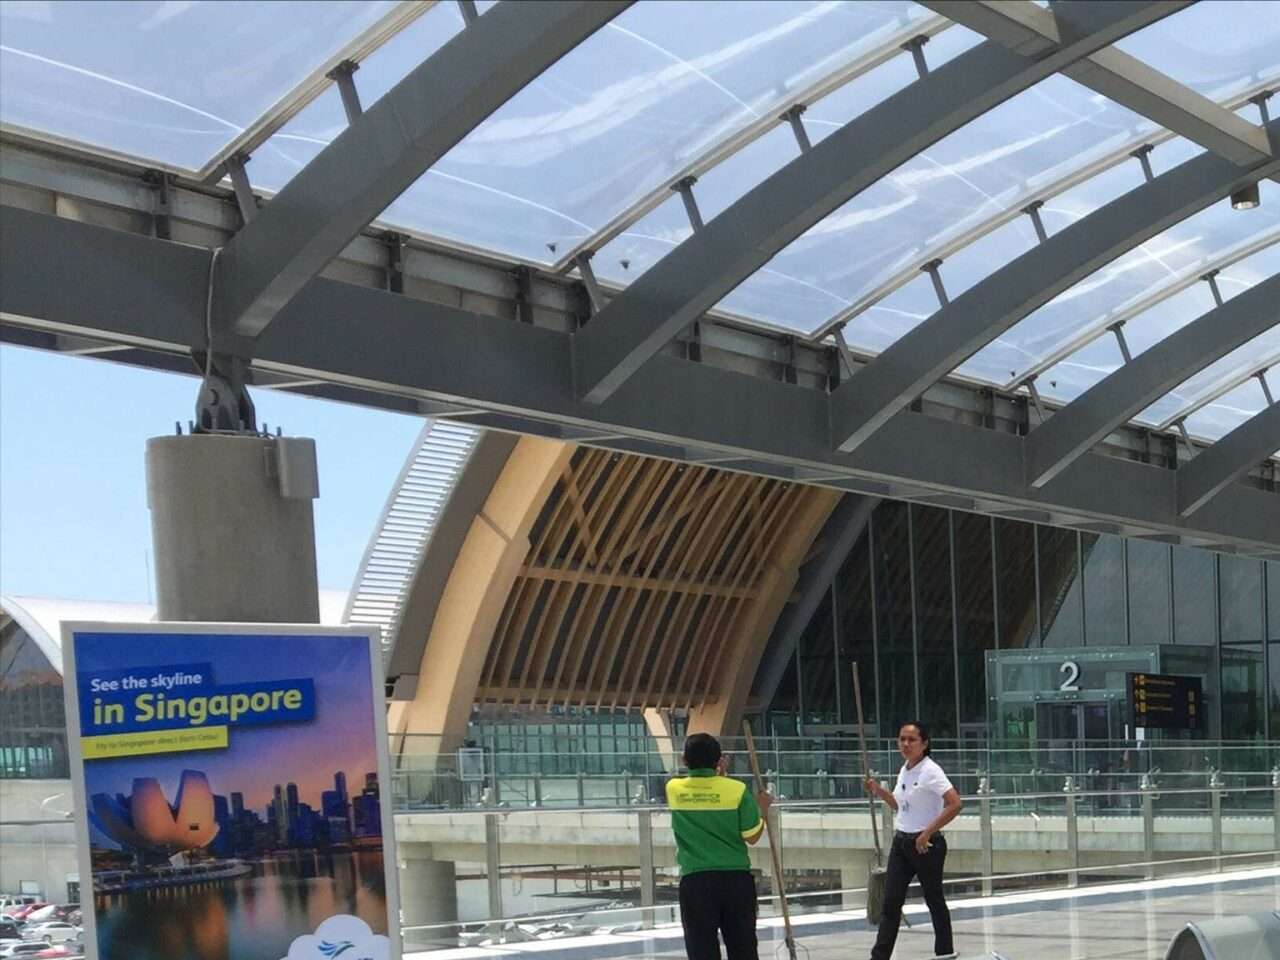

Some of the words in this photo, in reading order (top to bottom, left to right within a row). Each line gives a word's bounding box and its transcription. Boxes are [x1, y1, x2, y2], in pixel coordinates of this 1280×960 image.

[91, 678, 118, 692] See
[121, 676, 148, 690] the
[151, 672, 202, 690] skyline
[1060, 661, 1080, 691] 2
[93, 698, 125, 725] in
[134, 688, 303, 725] Singapore
